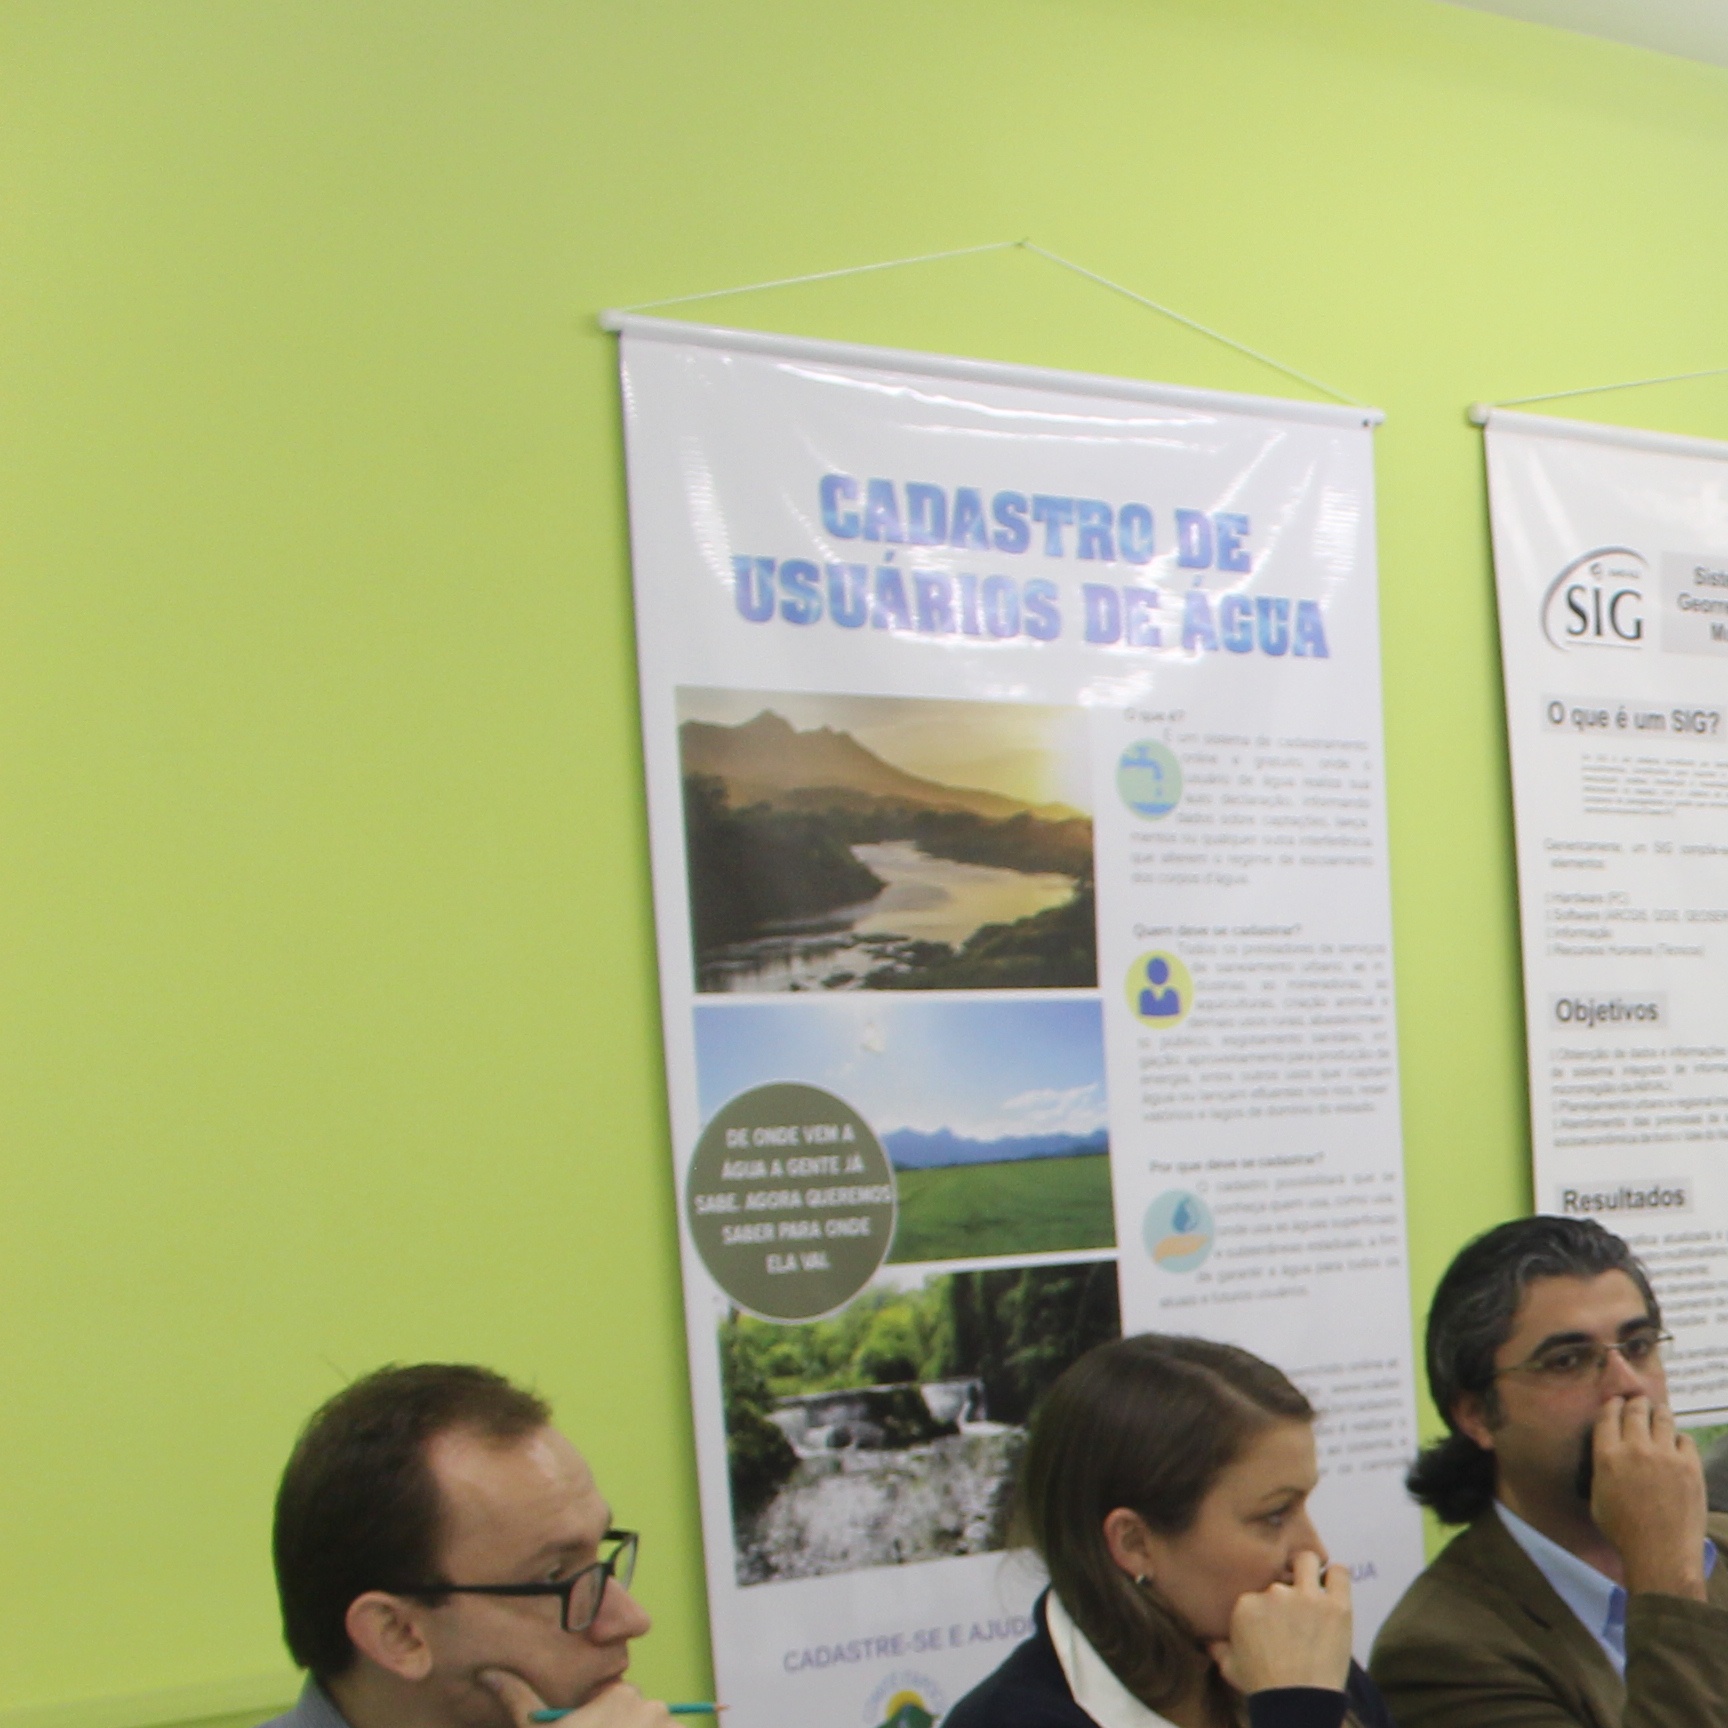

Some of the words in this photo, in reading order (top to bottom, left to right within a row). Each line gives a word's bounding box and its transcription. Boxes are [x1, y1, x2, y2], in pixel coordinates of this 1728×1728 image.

[819, 474, 1155, 568] CADASTRO
[1175, 508, 1252, 574] DE
[732, 551, 1062, 644] USUÁRIOS
[1082, 581, 1161, 649] DE
[1181, 571, 1330, 660] ÁGUA
[1566, 584, 1643, 641] SIG
[1547, 702, 1564, 725] O
[1572, 706, 1610, 732] que
[1615, 704, 1629, 729] é
[1635, 710, 1667, 733] um
[1672, 708, 1720, 735] SIG?
[1555, 997, 1660, 1028] Objetivos
[725, 1128, 749, 1149] DE
[842, 1124, 855, 1143] A
[770, 1159, 783, 1178] A
[1563, 1185, 1685, 1216] Resultados
[766, 1253, 797, 1274] ELA
[784, 1627, 943, 1674] CADASTRE-SE
[949, 1624, 963, 1648] E
[969, 1616, 1036, 1643] AJUD
